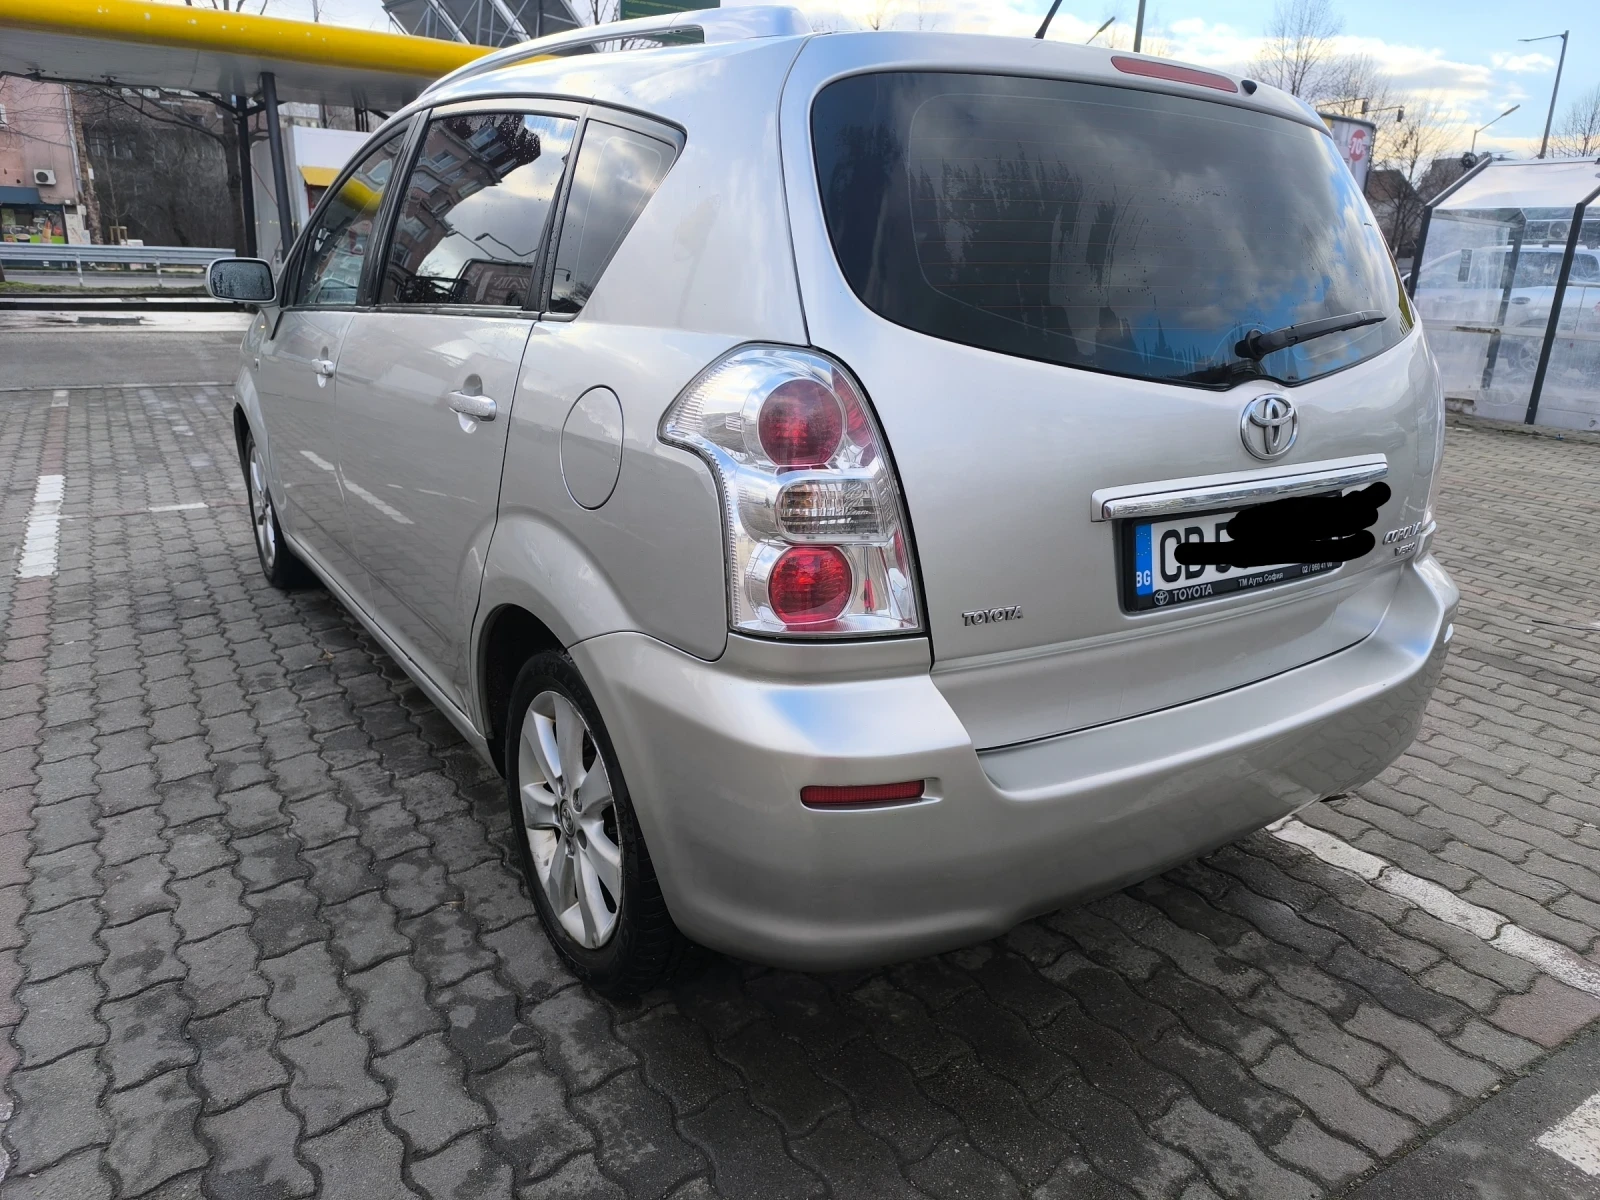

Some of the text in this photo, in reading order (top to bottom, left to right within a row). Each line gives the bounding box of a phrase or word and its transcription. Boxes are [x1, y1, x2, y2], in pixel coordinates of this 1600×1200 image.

[1136, 570, 1151, 587] BG
[1263, 572, 1284, 582] София
[1172, 584, 1214, 601] TOYOTA
[961, 605, 1023, 627] TOYOTA
